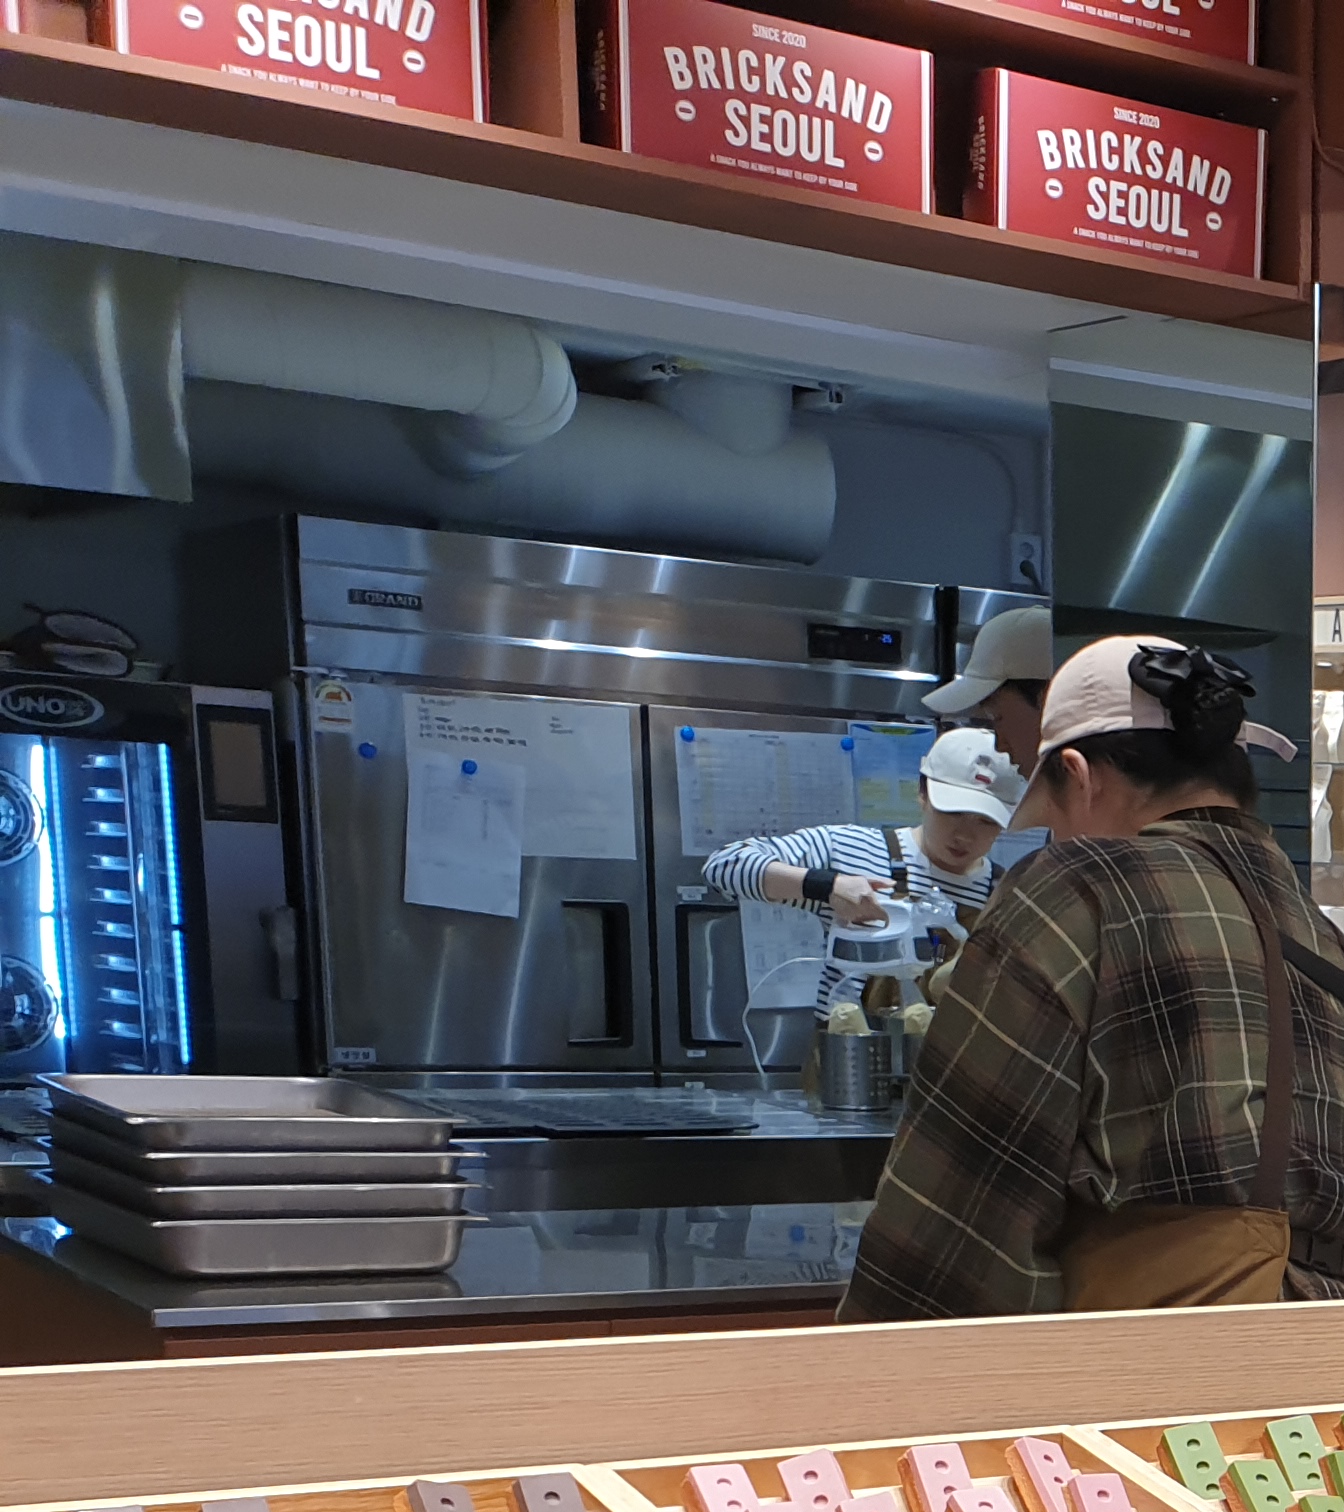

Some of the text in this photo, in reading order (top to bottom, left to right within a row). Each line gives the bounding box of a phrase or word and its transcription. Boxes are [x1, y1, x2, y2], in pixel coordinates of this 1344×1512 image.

[237, 4, 380, 80] SEOUL
[752, 24, 807, 48] SINCE 2020
[663, 45, 893, 134] BRICKSAND
[1113, 106, 1138, 124] SINCE
[723, 98, 845, 168] SEOUL
[1037, 128, 1232, 205] BRICKSAND
[1086, 176, 1189, 238] SEOUL
